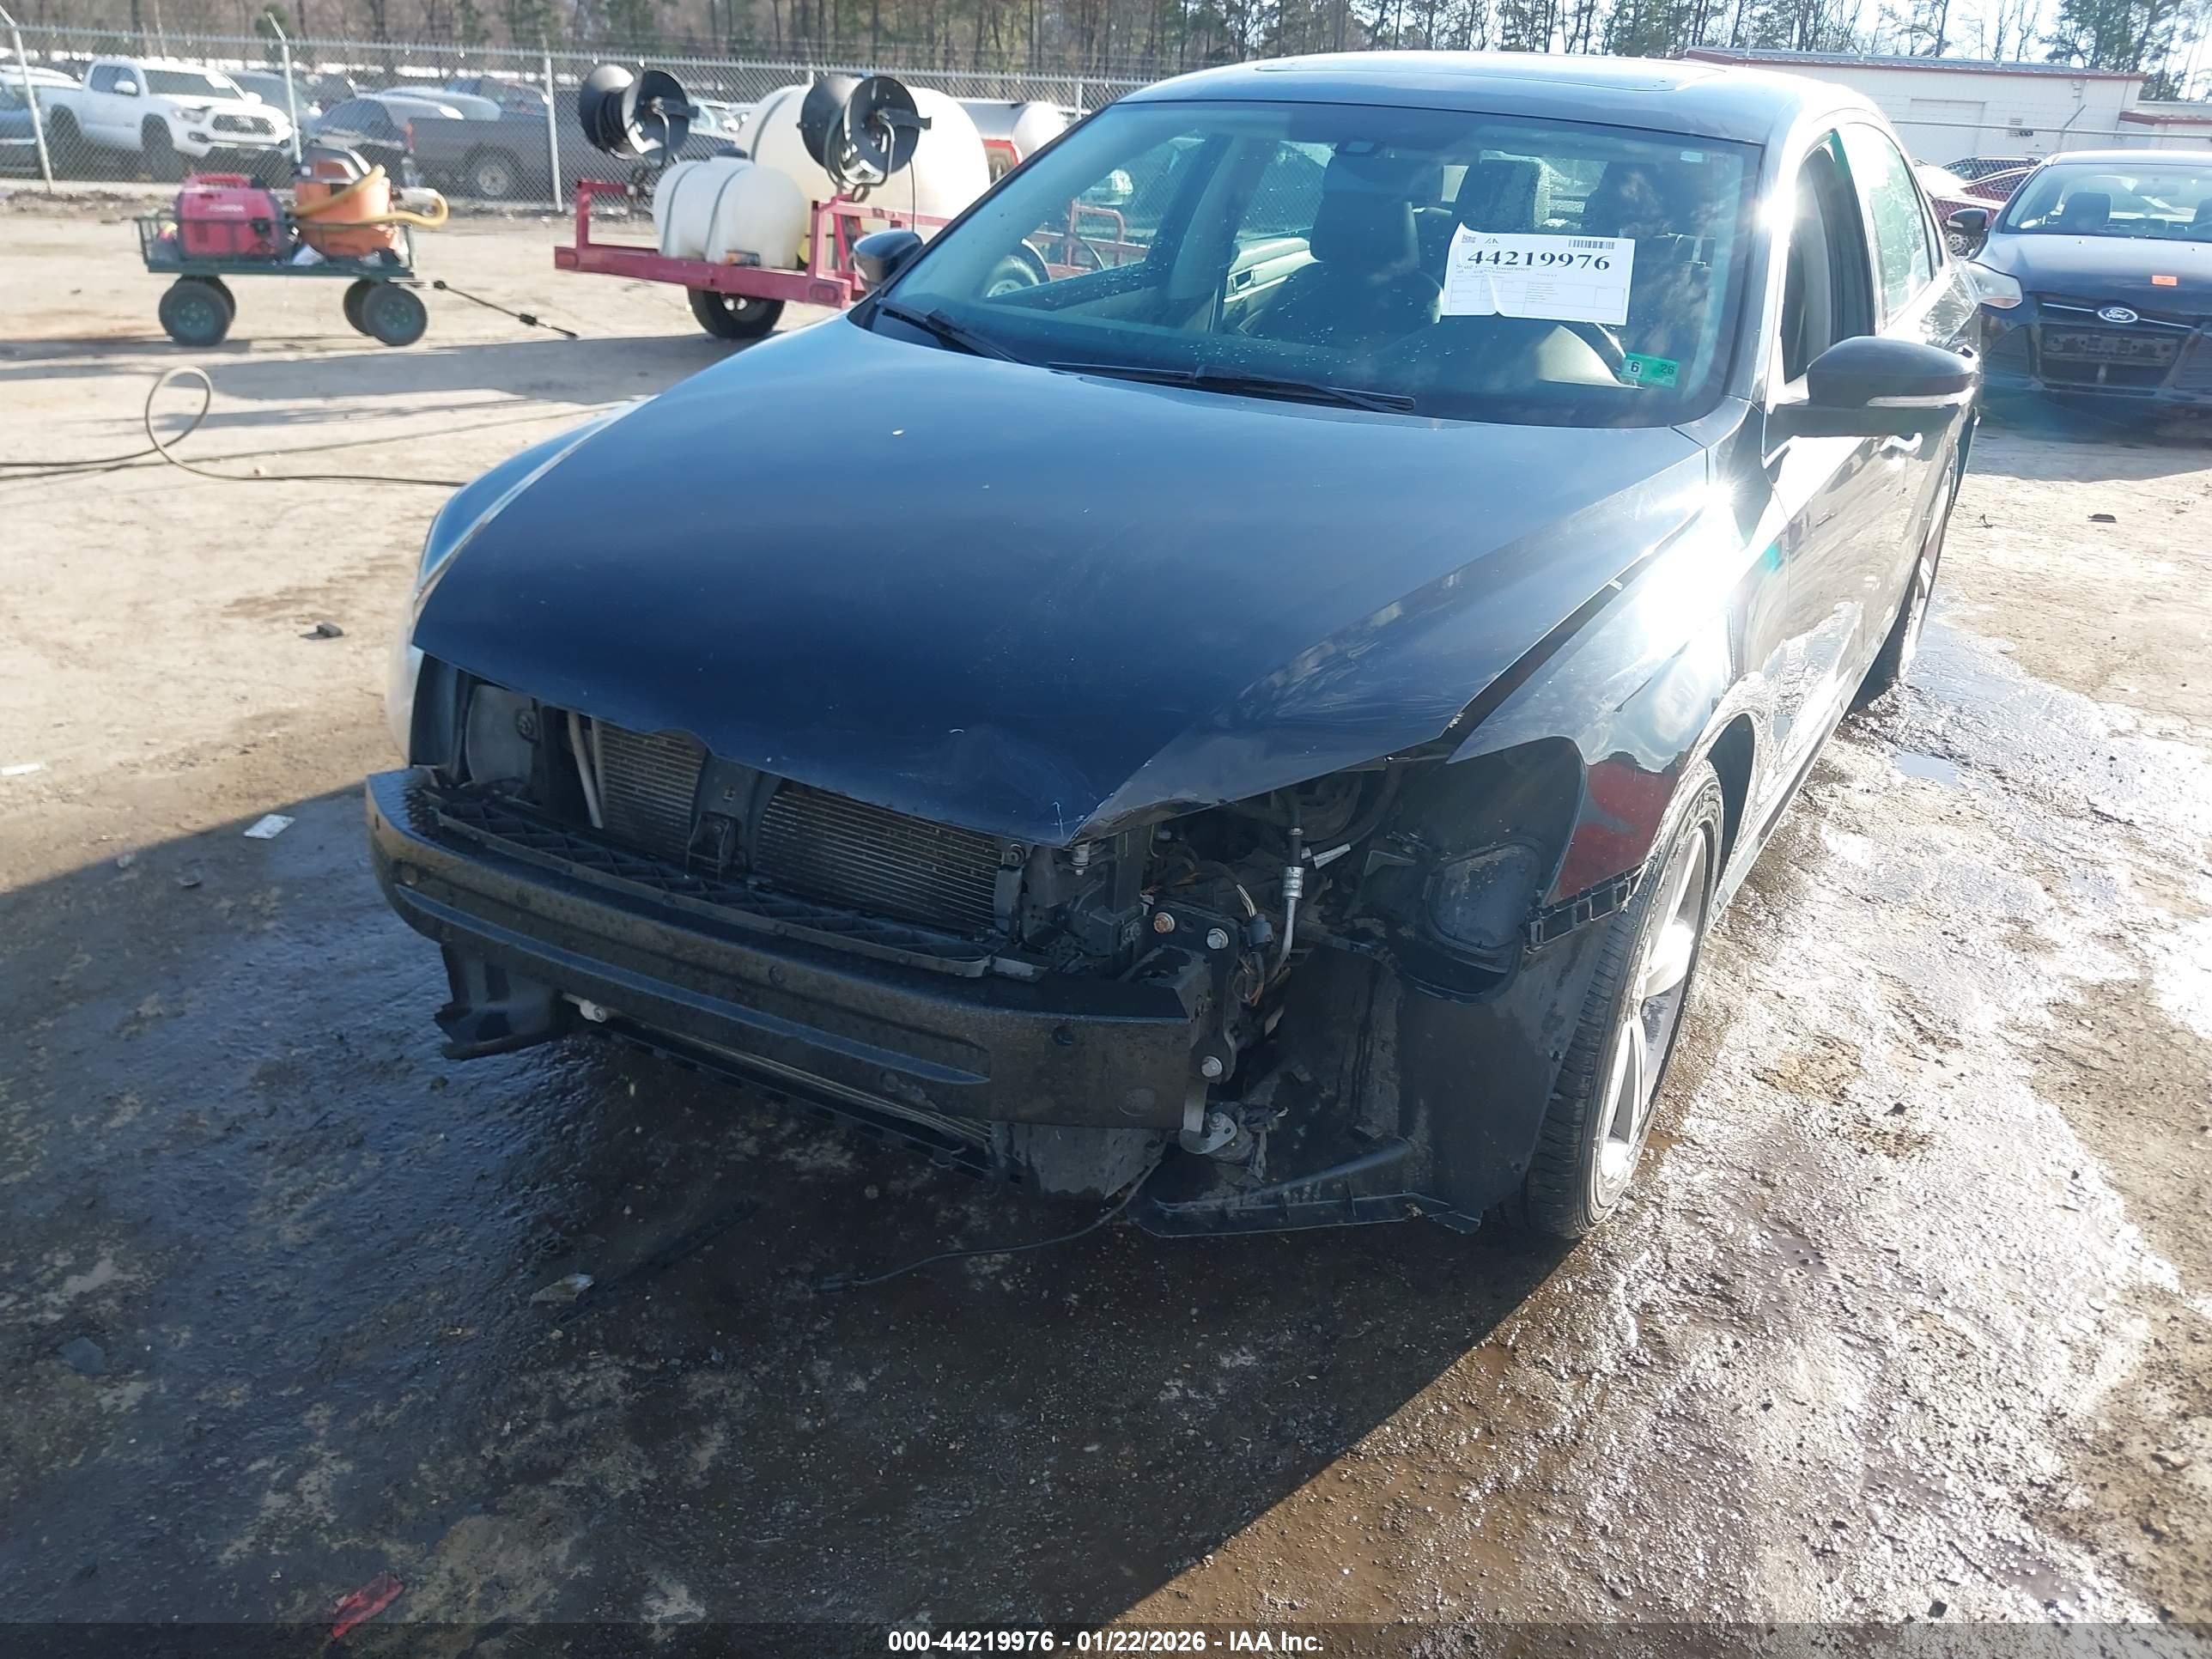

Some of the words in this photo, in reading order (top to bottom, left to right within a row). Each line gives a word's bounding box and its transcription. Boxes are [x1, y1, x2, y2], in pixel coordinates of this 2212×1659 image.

[1467, 250, 1610, 270] 44219976
[2106, 308, 2130, 320] Ford
[1631, 361, 1640, 373] 6
[1660, 363, 1675, 375] 26
